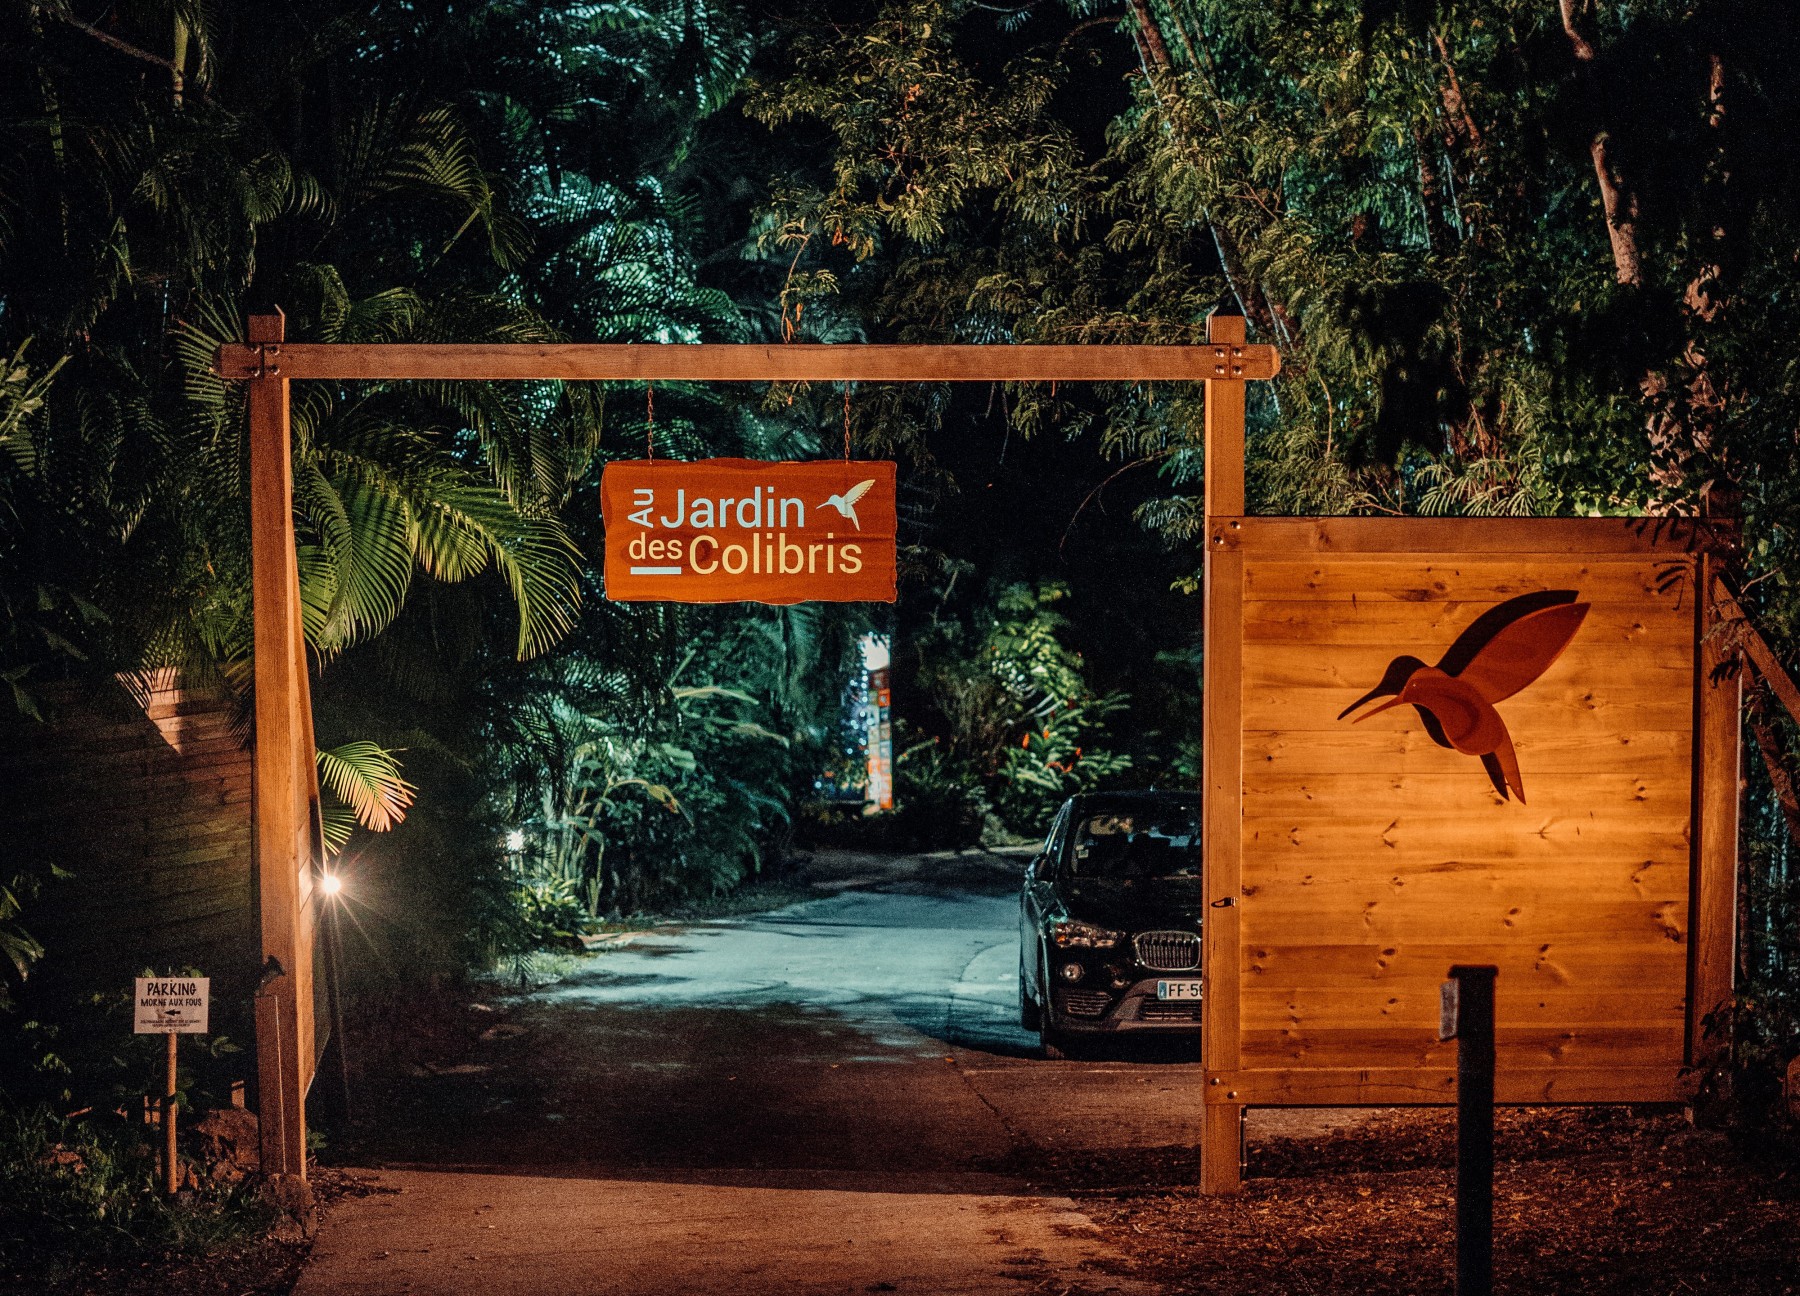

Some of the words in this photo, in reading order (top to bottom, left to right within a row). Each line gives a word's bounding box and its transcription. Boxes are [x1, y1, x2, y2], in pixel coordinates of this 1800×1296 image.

[627, 488, 654, 528] Au
[660, 486, 805, 529] Jardin
[628, 532, 683, 560] des
[689, 532, 863, 575] Colibris
[140, 998, 167, 1007] MORNE
[168, 998, 184, 1007] AUX
[185, 998, 202, 1007] FOUS
[147, 982, 197, 996] PARKING
